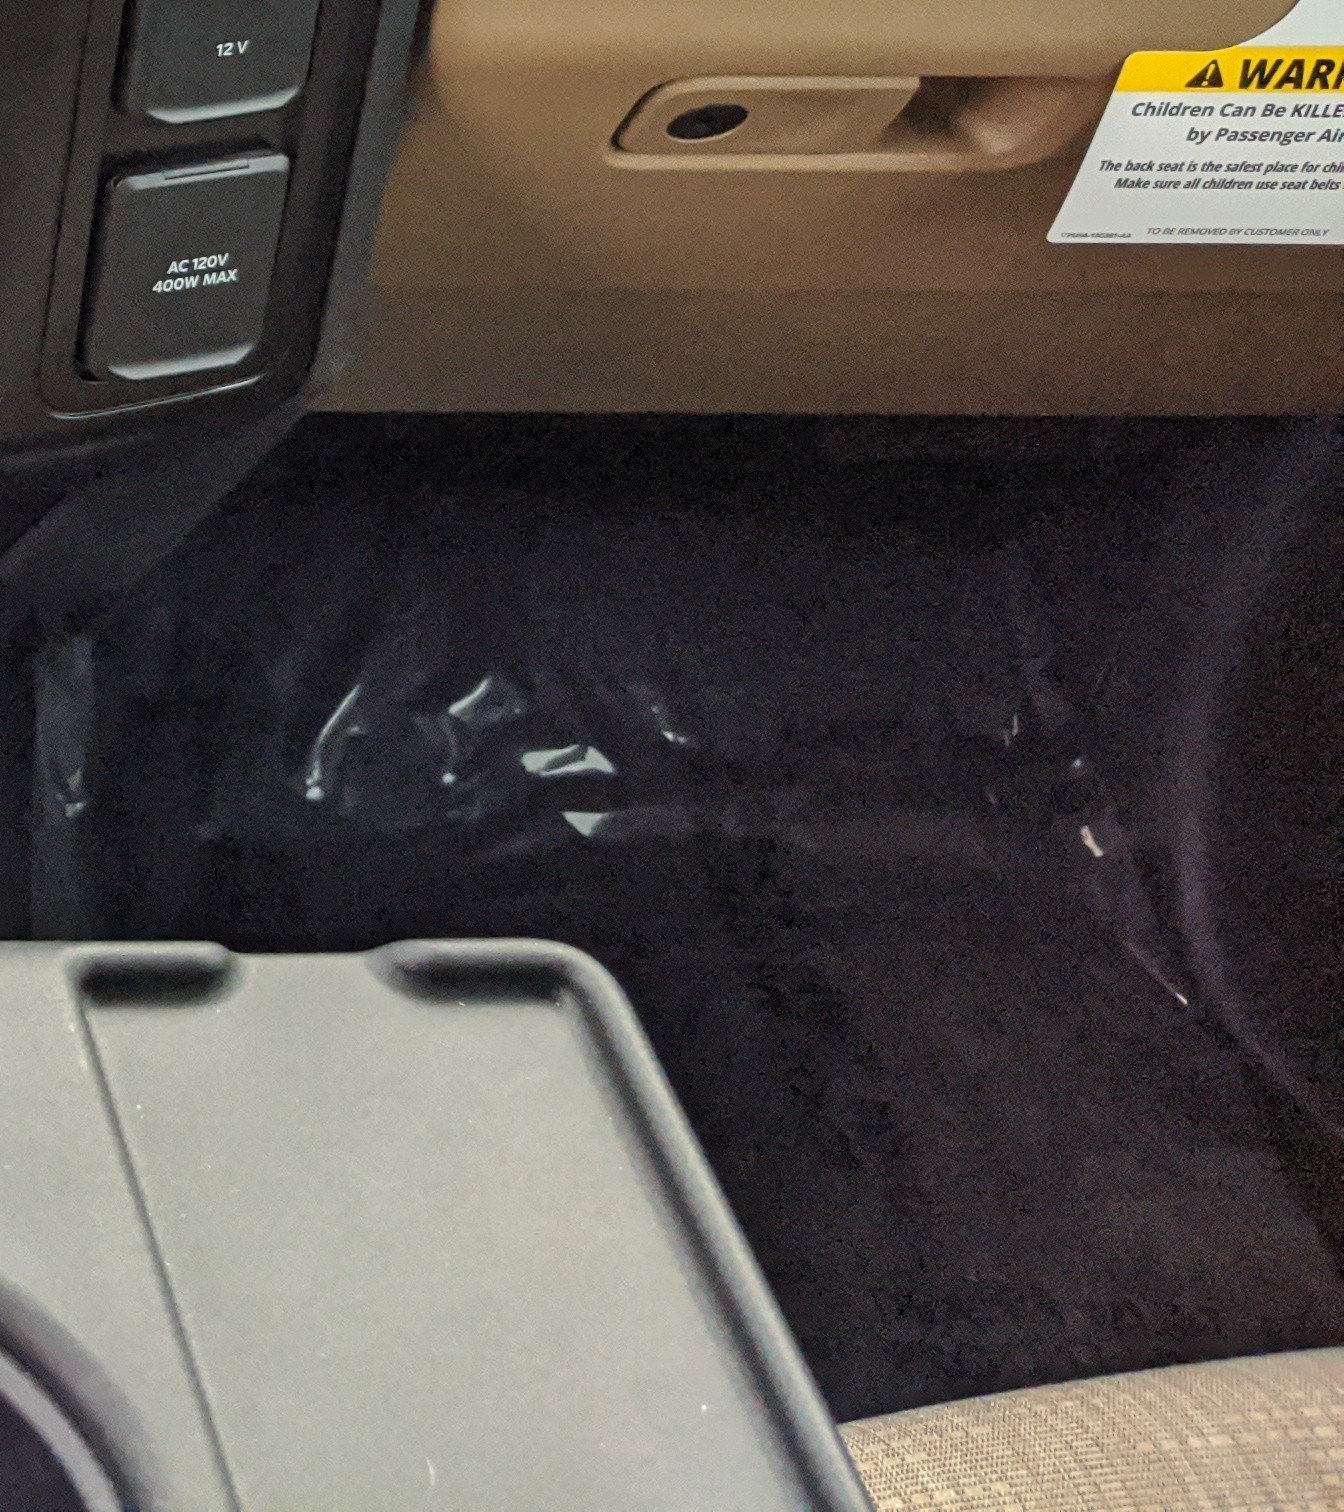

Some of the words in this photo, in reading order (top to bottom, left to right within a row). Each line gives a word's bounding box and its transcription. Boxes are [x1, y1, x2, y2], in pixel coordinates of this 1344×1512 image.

[217, 41, 234, 57] 12
[236, 40, 249, 55] V
[1131, 100, 1214, 118] Children
[1219, 102, 1257, 118] Can
[1260, 103, 1287, 118] Be
[1186, 126, 1211, 145] by
[1215, 127, 1316, 146] Passenger
[1099, 160, 1123, 173] The
[1125, 160, 1154, 173] back
[1157, 161, 1184, 173] seat
[1187, 161, 1198, 173] is
[1201, 161, 1223, 173] the
[1226, 161, 1263, 173] safest
[1263, 161, 1299, 176] place
[1300, 161, 1321, 174] for
[1322, 162, 1344, 174] chi
[1114, 177, 1151, 190] Make
[1154, 179, 1181, 190] sure
[1183, 178, 1200, 190] all
[1202, 178, 1254, 190] children
[1255, 179, 1279, 190] use
[1280, 179, 1308, 190] seat
[1309, 178, 1341, 191] belts
[1147, 227, 1161, 236] TO
[1164, 227, 1176, 236] BE
[1177, 227, 1226, 237] REMOVED
[1228, 228, 1242, 237] BY
[1243, 228, 1300, 237] CUSTOMER
[1301, 228, 1329, 237] ONLY
[166, 259, 190, 275] AC
[192, 252, 229, 270] 120V
[152, 274, 199, 293] 400W
[202, 268, 238, 287] MAX
